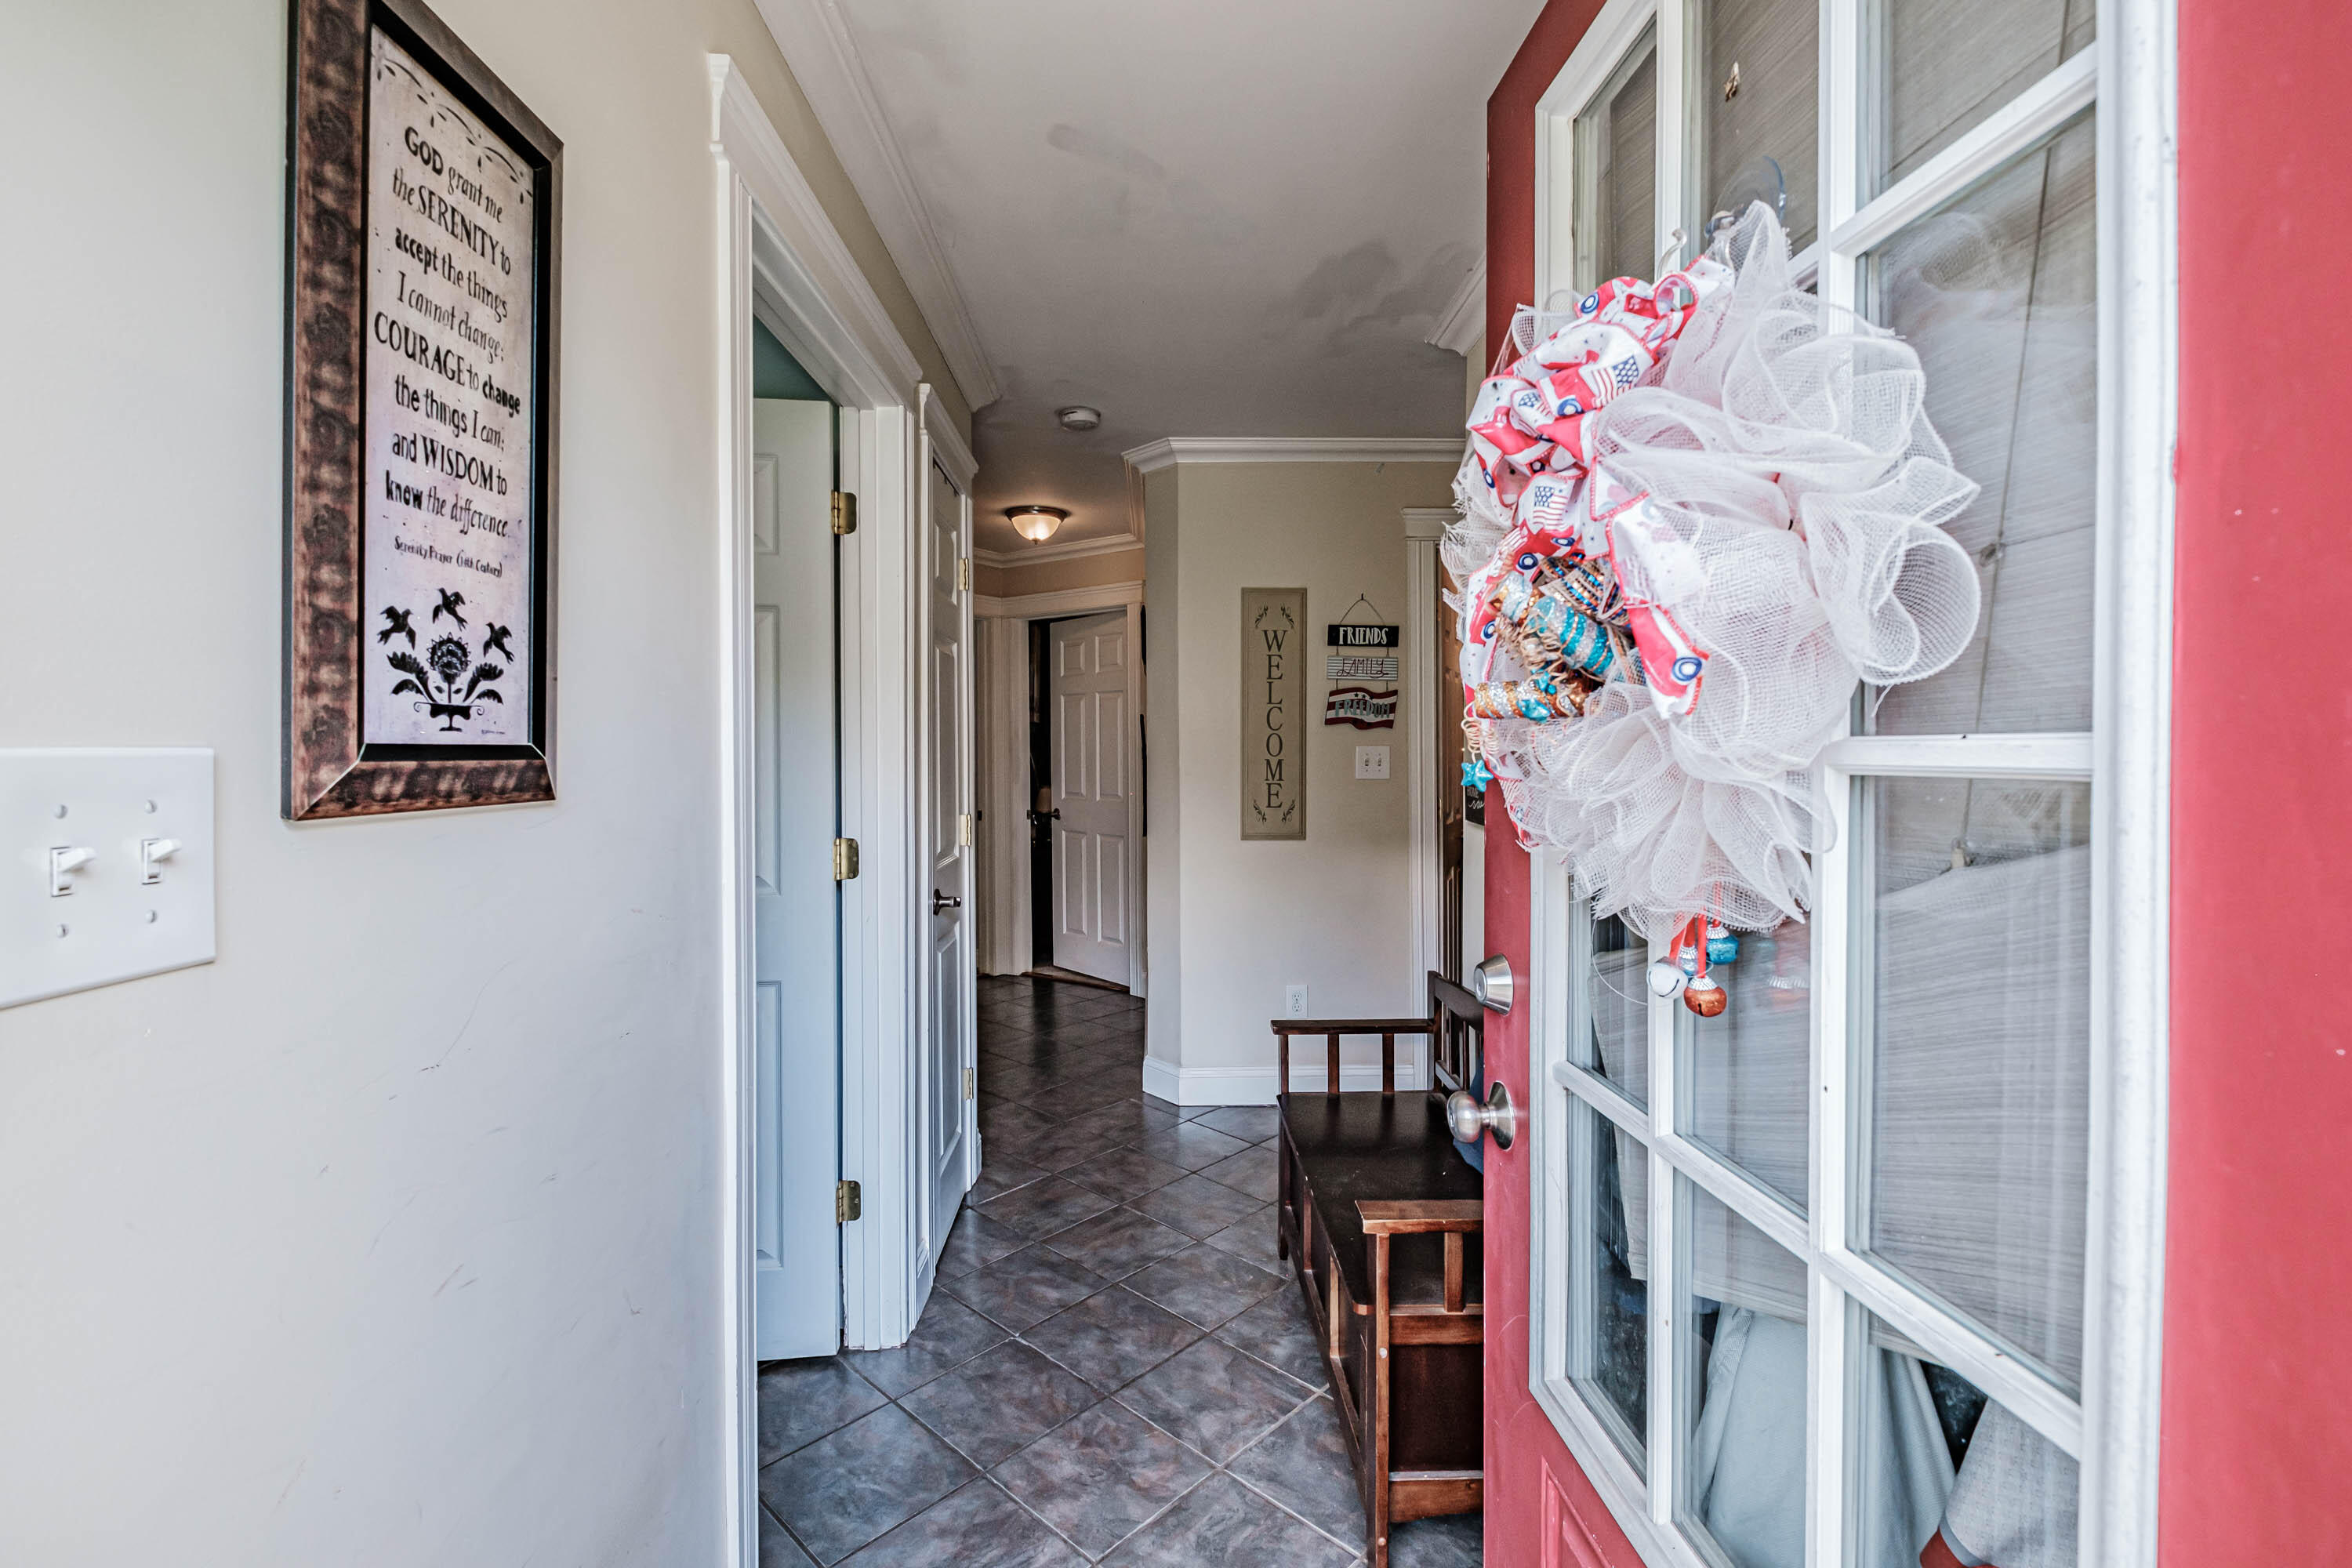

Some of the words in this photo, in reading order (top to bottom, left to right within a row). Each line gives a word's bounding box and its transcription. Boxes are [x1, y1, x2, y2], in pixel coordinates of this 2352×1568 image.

[405, 125, 444, 176] GOD
[448, 166, 483, 206] grant
[485, 195, 503, 223] me
[392, 167, 415, 206] the
[417, 185, 499, 266] SERENITY
[500, 245, 511, 275] to
[394, 227, 437, 274] accept
[441, 252, 464, 289] the
[467, 270, 508, 323] things
[397, 270, 406, 303] I
[408, 289, 456, 331] cannot
[374, 310, 466, 387] COURAGE
[466, 363, 480, 391] to
[482, 374, 521, 418] change
[395, 374, 420, 412] the
[423, 388, 467, 438] things
[471, 409, 479, 439] I
[386, 470, 423, 510] know
[426, 485, 447, 517] the
[392, 433, 417, 463] and
[420, 434, 493, 492] WISDOM
[496, 468, 507, 496] to
[394, 535, 428, 559] Serenity
[429, 545, 452, 564] Prayer
[1338, 626, 1388, 644] FRIENDS
[1336, 658, 1389, 679] FAMILY
[1261, 629, 1288, 809] WELCOME
[1334, 699, 1390, 719] FREEDOM
